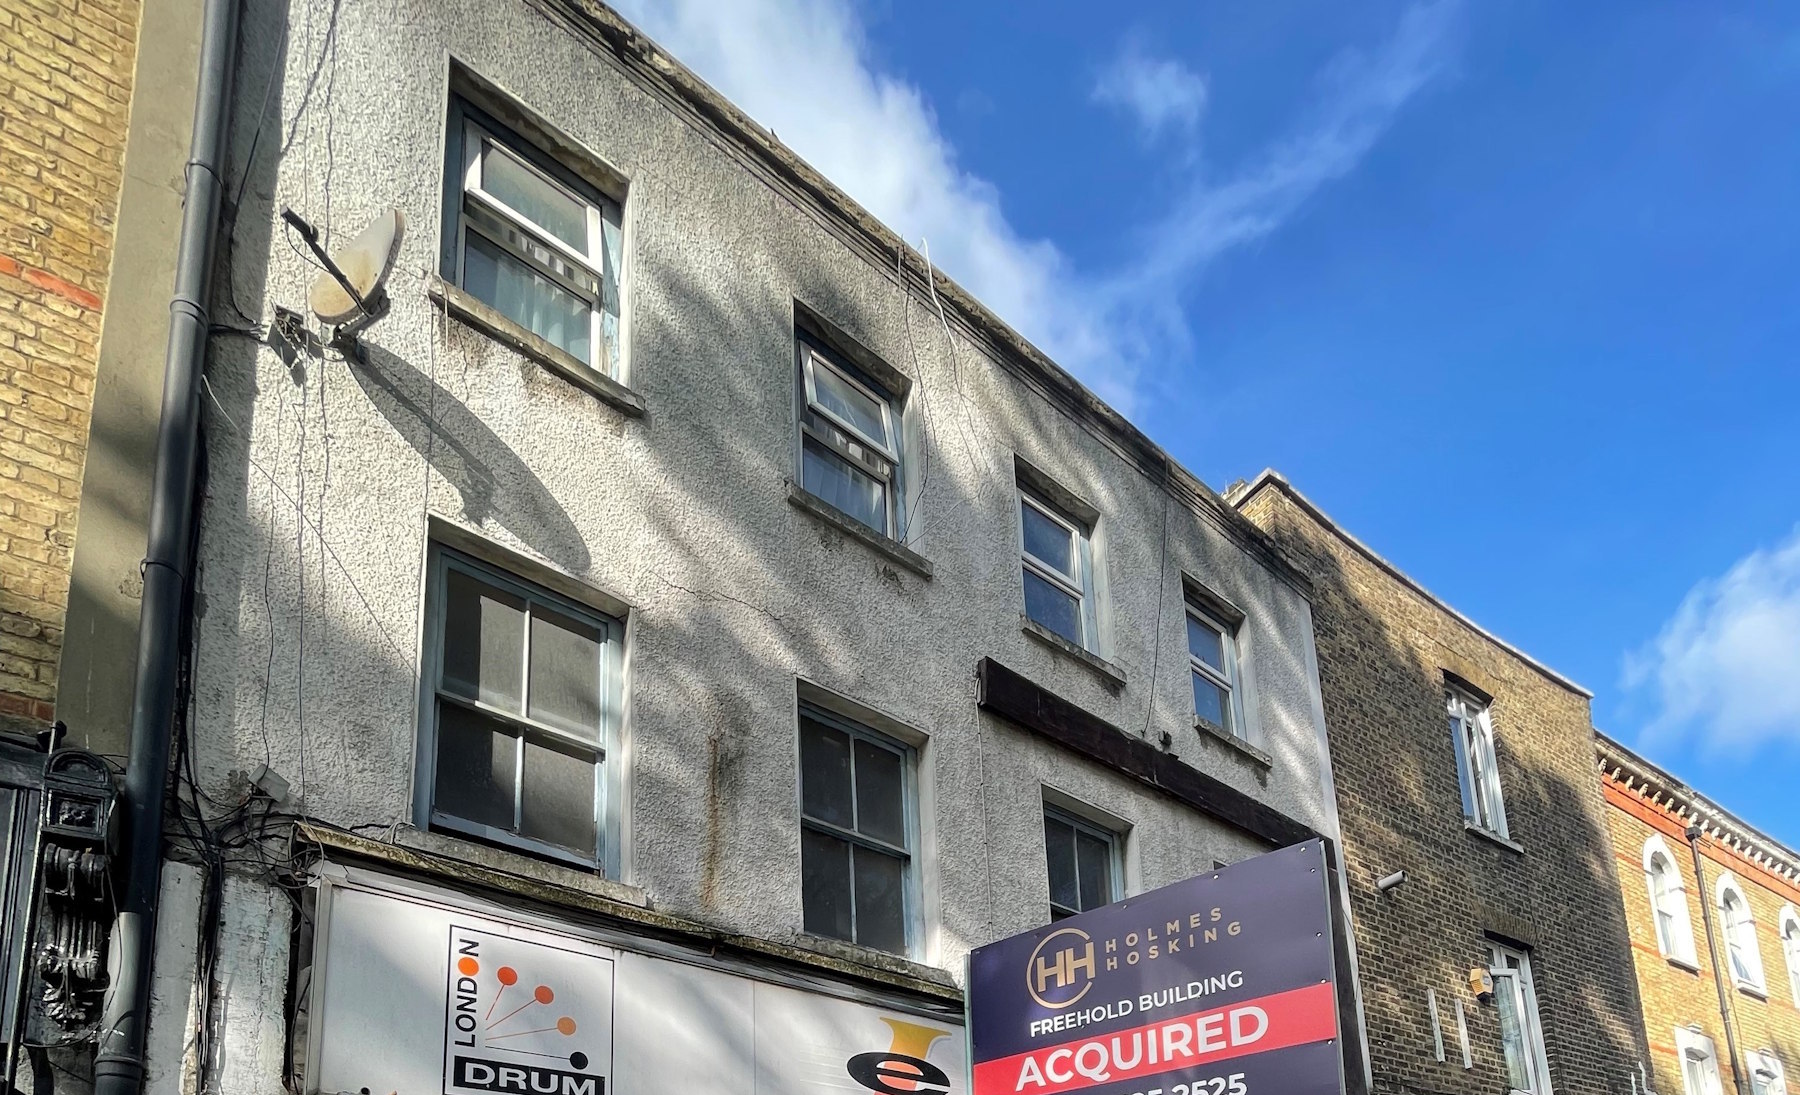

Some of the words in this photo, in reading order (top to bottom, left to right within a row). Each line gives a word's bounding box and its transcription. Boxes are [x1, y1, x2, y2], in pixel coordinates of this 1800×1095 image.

[1105, 907, 1223, 954] HOLMES
[1106, 921, 1242, 972] HOSKING
[454, 937, 480, 1048] LONDON
[1029, 999, 1134, 1038] FREEHOLD
[1138, 970, 1244, 1012] BUILDING
[1015, 1005, 1269, 1092] ACQUIRED
